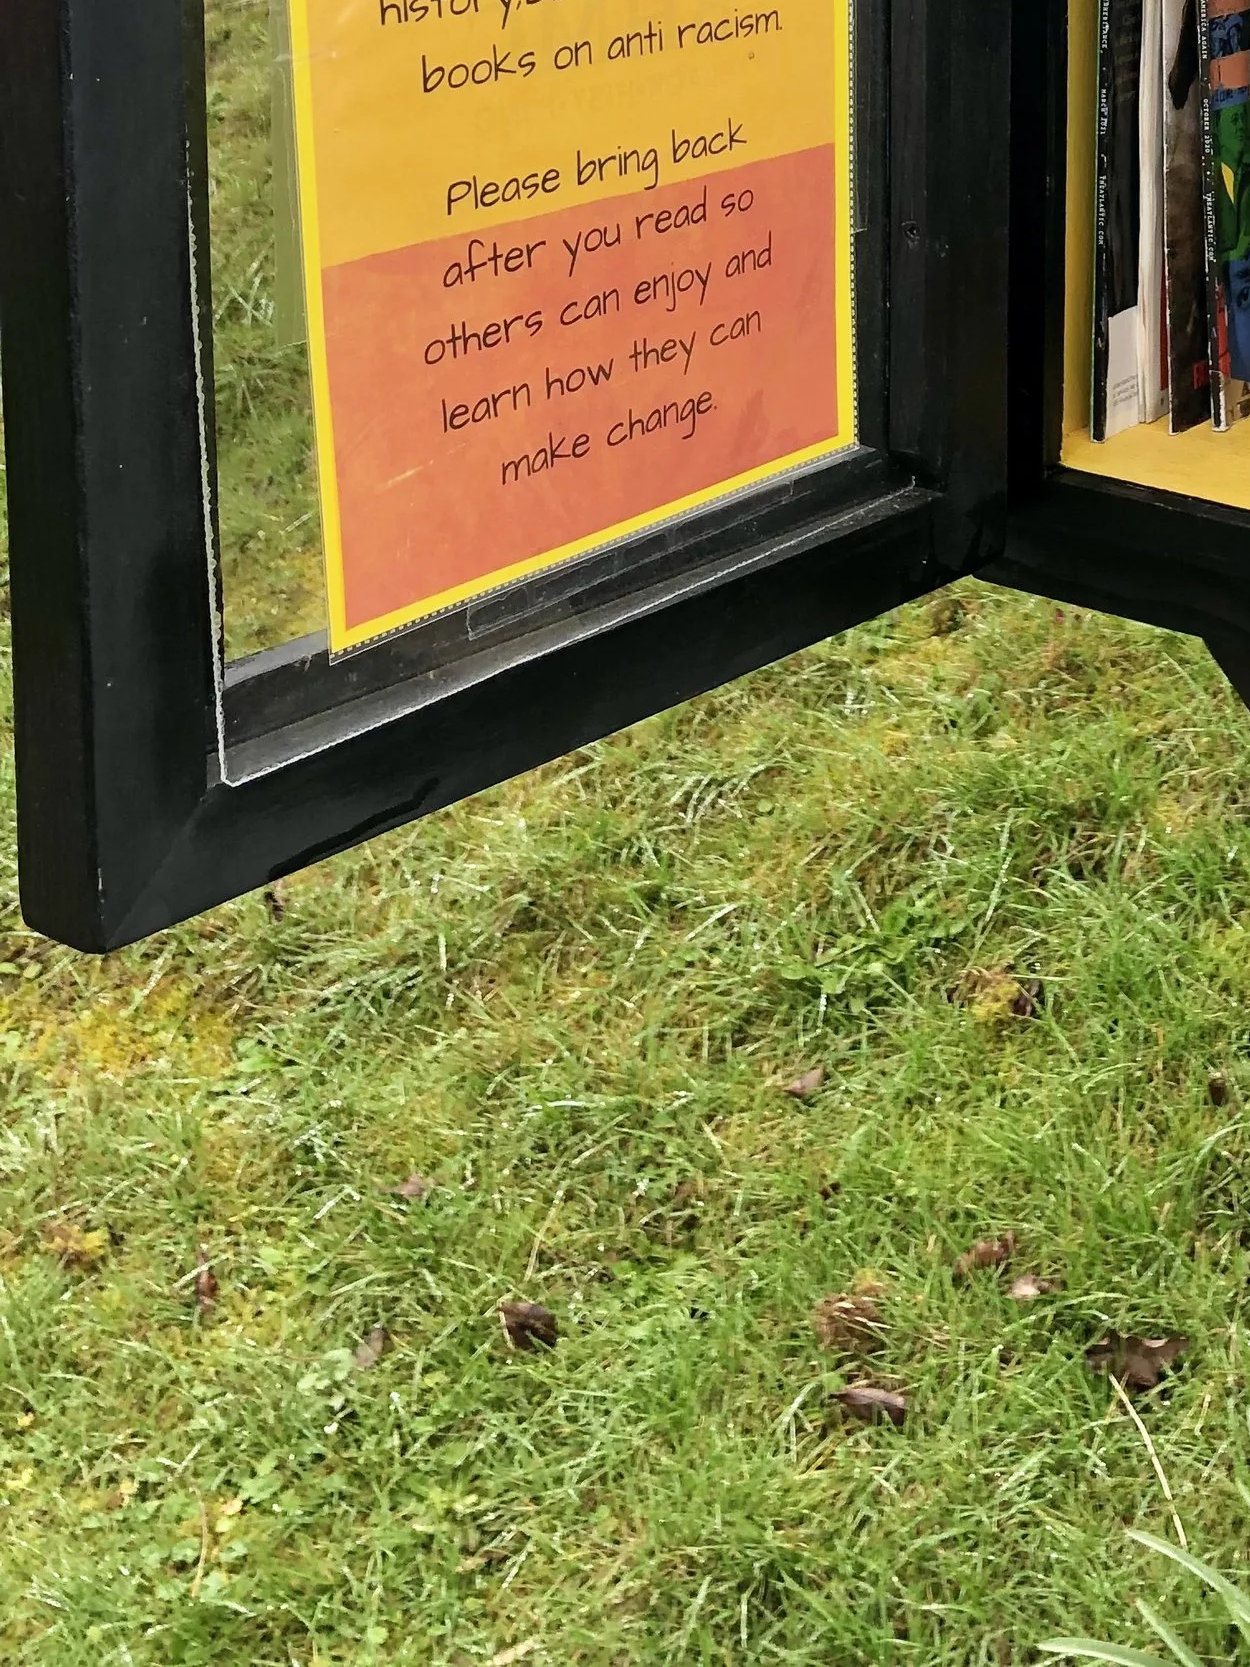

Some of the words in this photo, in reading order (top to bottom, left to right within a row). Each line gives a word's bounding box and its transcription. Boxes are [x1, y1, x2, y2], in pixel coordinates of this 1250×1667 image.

[422, 44, 537, 93] books
[554, 38, 593, 70] on
[607, 20, 664, 60] anti
[677, 7, 783, 50] racism.
[1200, 0, 1209, 33] AMERICA
[1201, 36, 1209, 60] AGAIN
[1203, 98, 1211, 131] OCTOBER
[446, 167, 561, 216] Please
[576, 145, 659, 190] bring
[672, 117, 748, 165] back
[442, 238, 547, 288] after
[562, 222, 622, 277] you
[634, 186, 708, 240] read
[720, 188, 755, 219] so
[423, 309, 543, 365] others
[559, 287, 620, 326] can
[633, 261, 713, 312] enjoy
[724, 230, 773, 279] and
[442, 380, 531, 433] learn
[544, 357, 615, 400] how
[628, 330, 697, 376] they
[708, 310, 762, 348] can
[501, 432, 592, 486] make
[605, 389, 718, 447] change.
